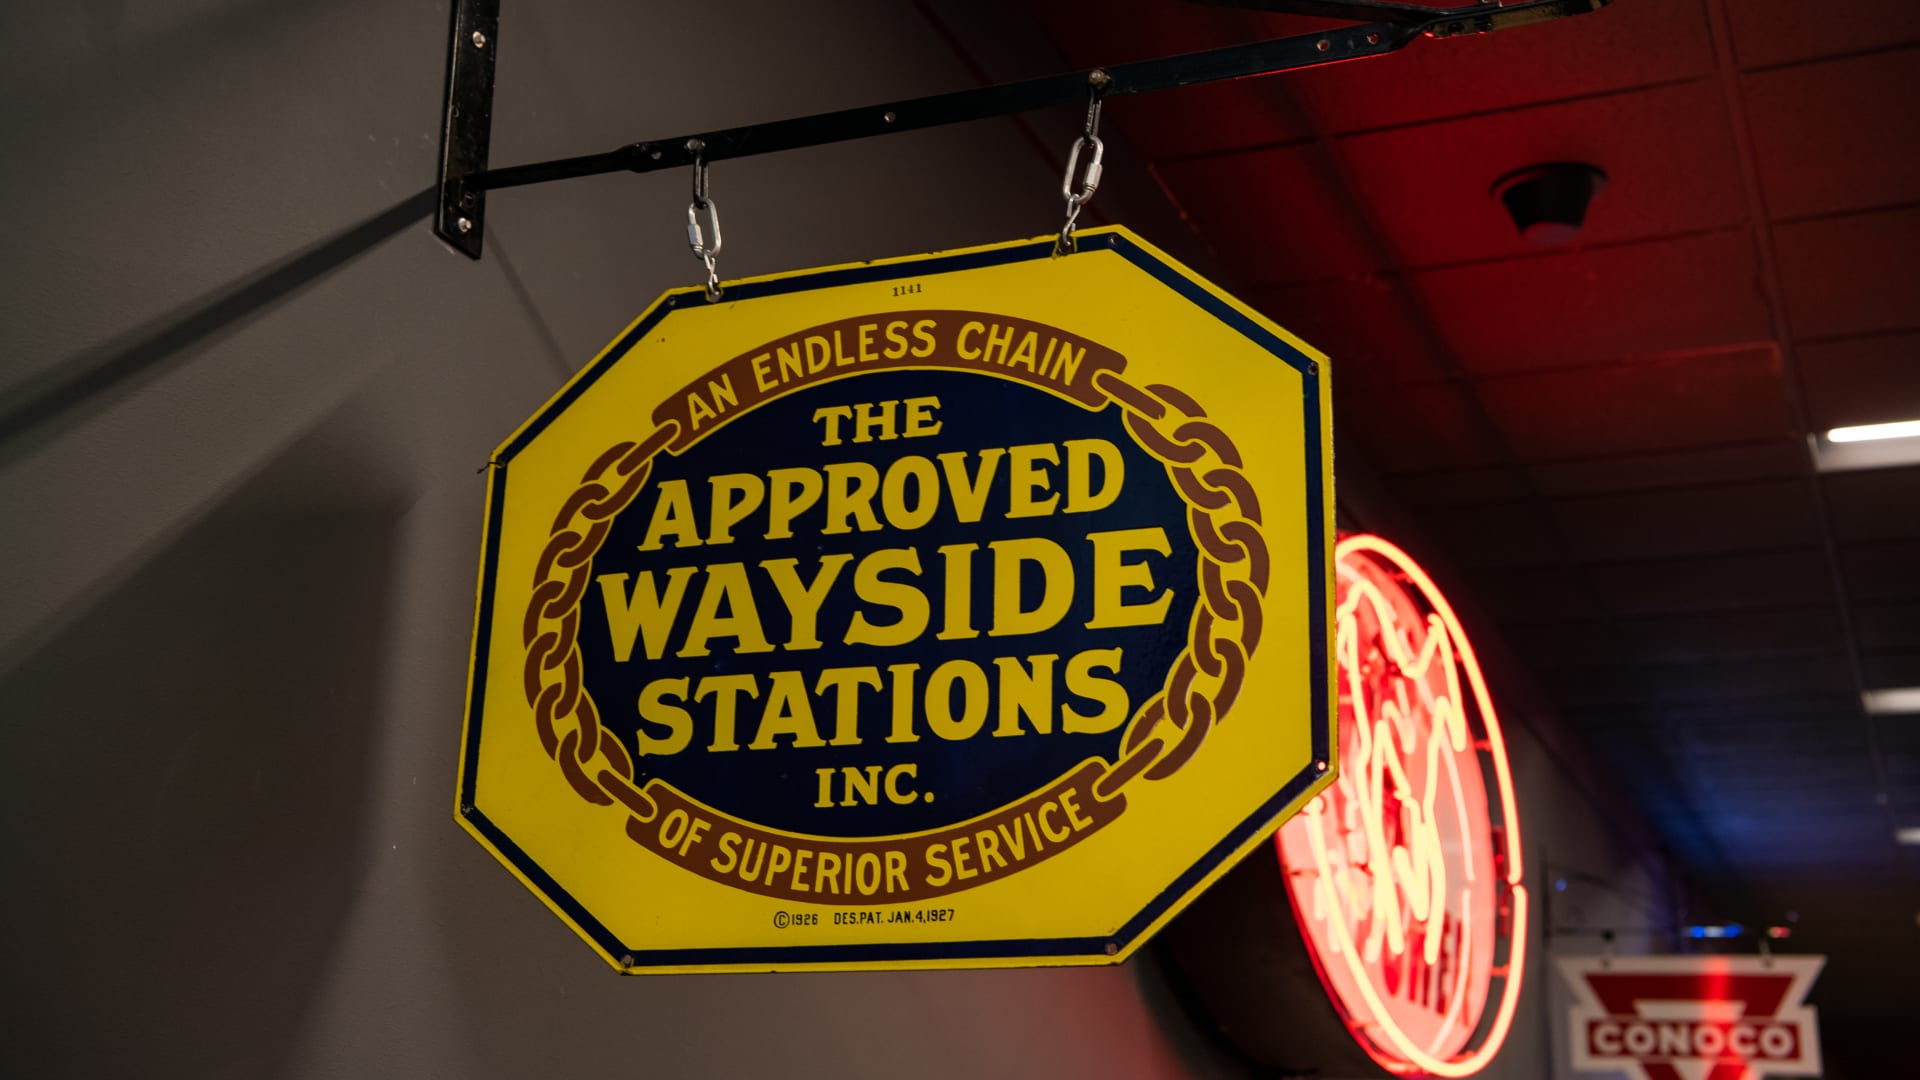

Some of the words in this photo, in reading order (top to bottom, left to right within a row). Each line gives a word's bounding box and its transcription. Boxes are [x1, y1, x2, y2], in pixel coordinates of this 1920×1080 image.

[892, 283, 922, 297] 1141
[688, 374, 740, 431] AN
[751, 319, 938, 393] ENDLESS
[956, 320, 1087, 386] CHAIN
[812, 396, 943, 447] THE
[638, 438, 1126, 551] APPROVED
[596, 527, 1175, 663] WAYSIDE
[637, 647, 1131, 757] STATIONS
[815, 764, 935, 808] INC.
[657, 808, 711, 857] OF
[711, 831, 910, 896] SUPERIOR
[925, 787, 1094, 887] SERVICE
[1593, 1024, 1796, 1057] CONOCO
